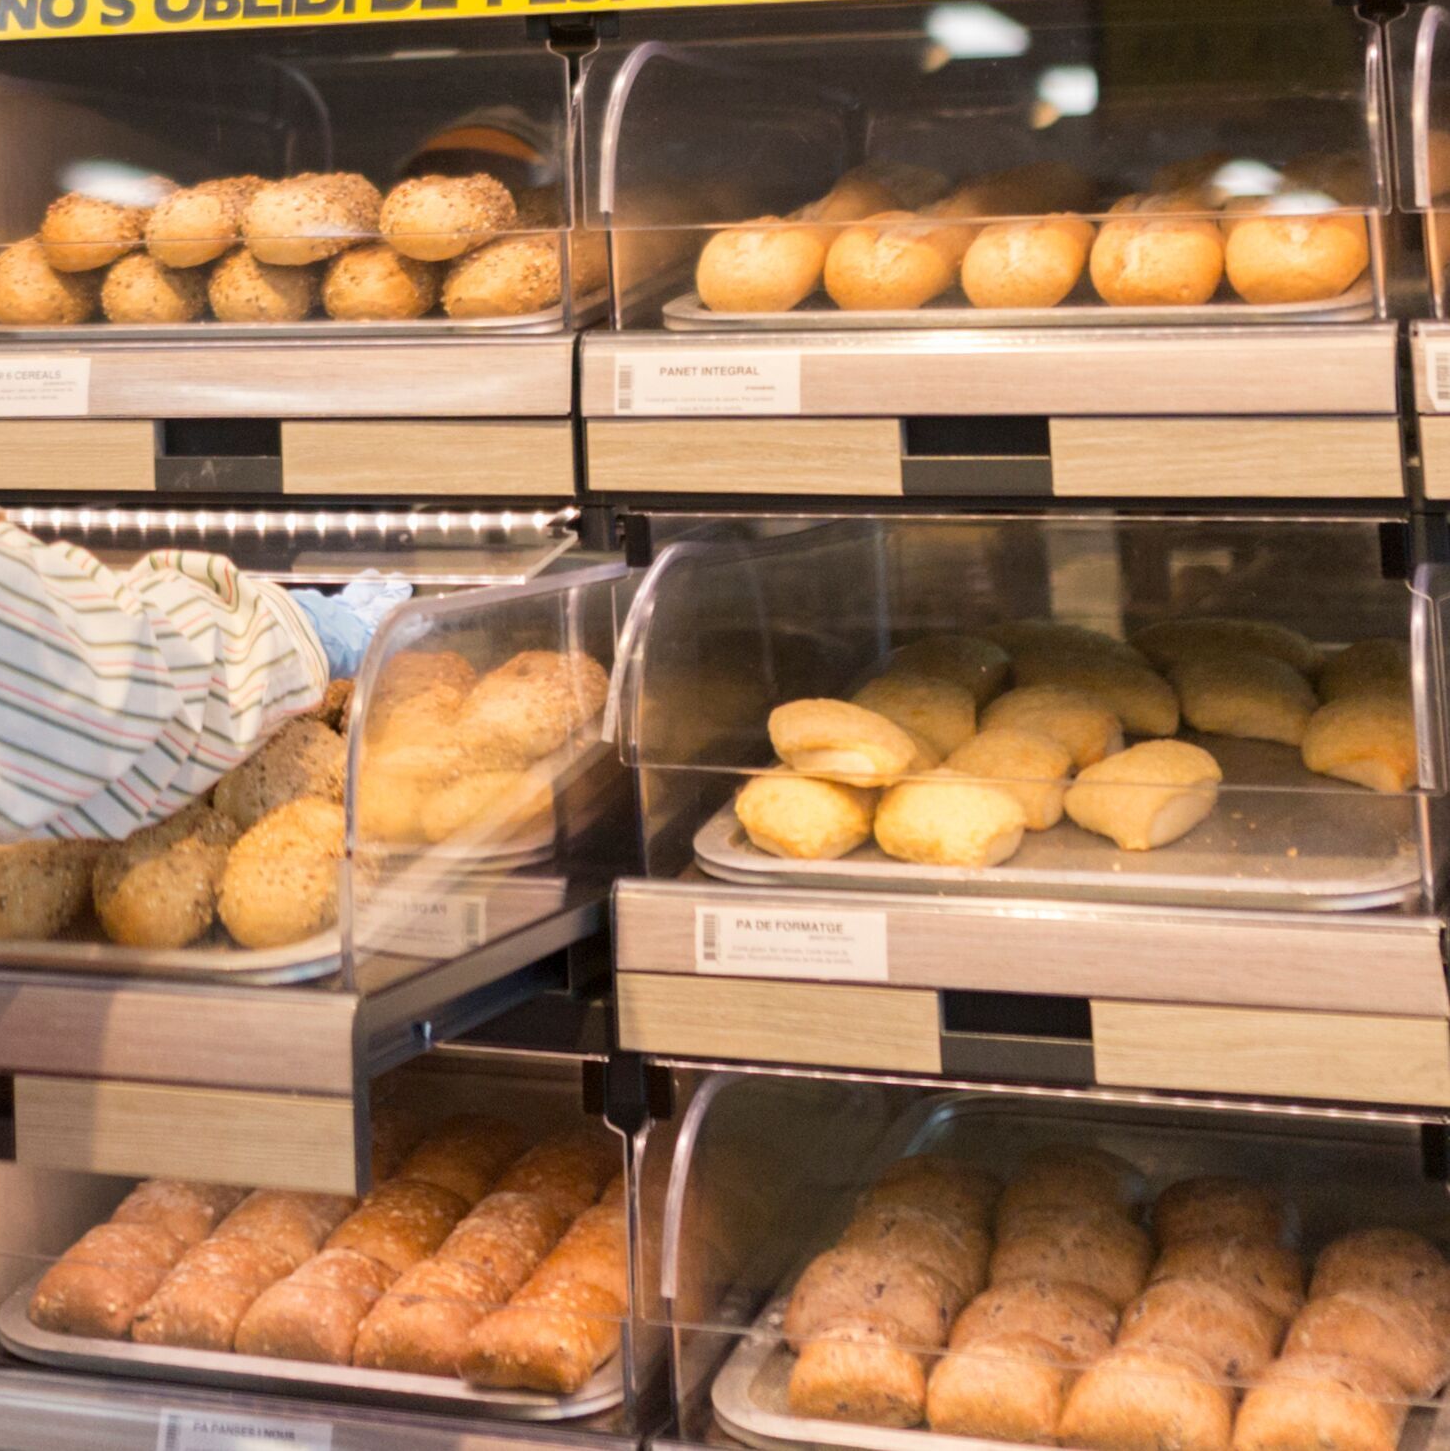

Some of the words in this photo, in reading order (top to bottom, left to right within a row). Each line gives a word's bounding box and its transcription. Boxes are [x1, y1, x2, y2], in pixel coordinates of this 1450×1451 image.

[14, 370, 62, 380] CEREALS
[659, 367, 698, 377] PANET
[700, 366, 760, 376] INTEGRAL
[736, 919, 752, 931] PA
[755, 920, 772, 932] DE
[775, 921, 844, 934] FORMATGE
